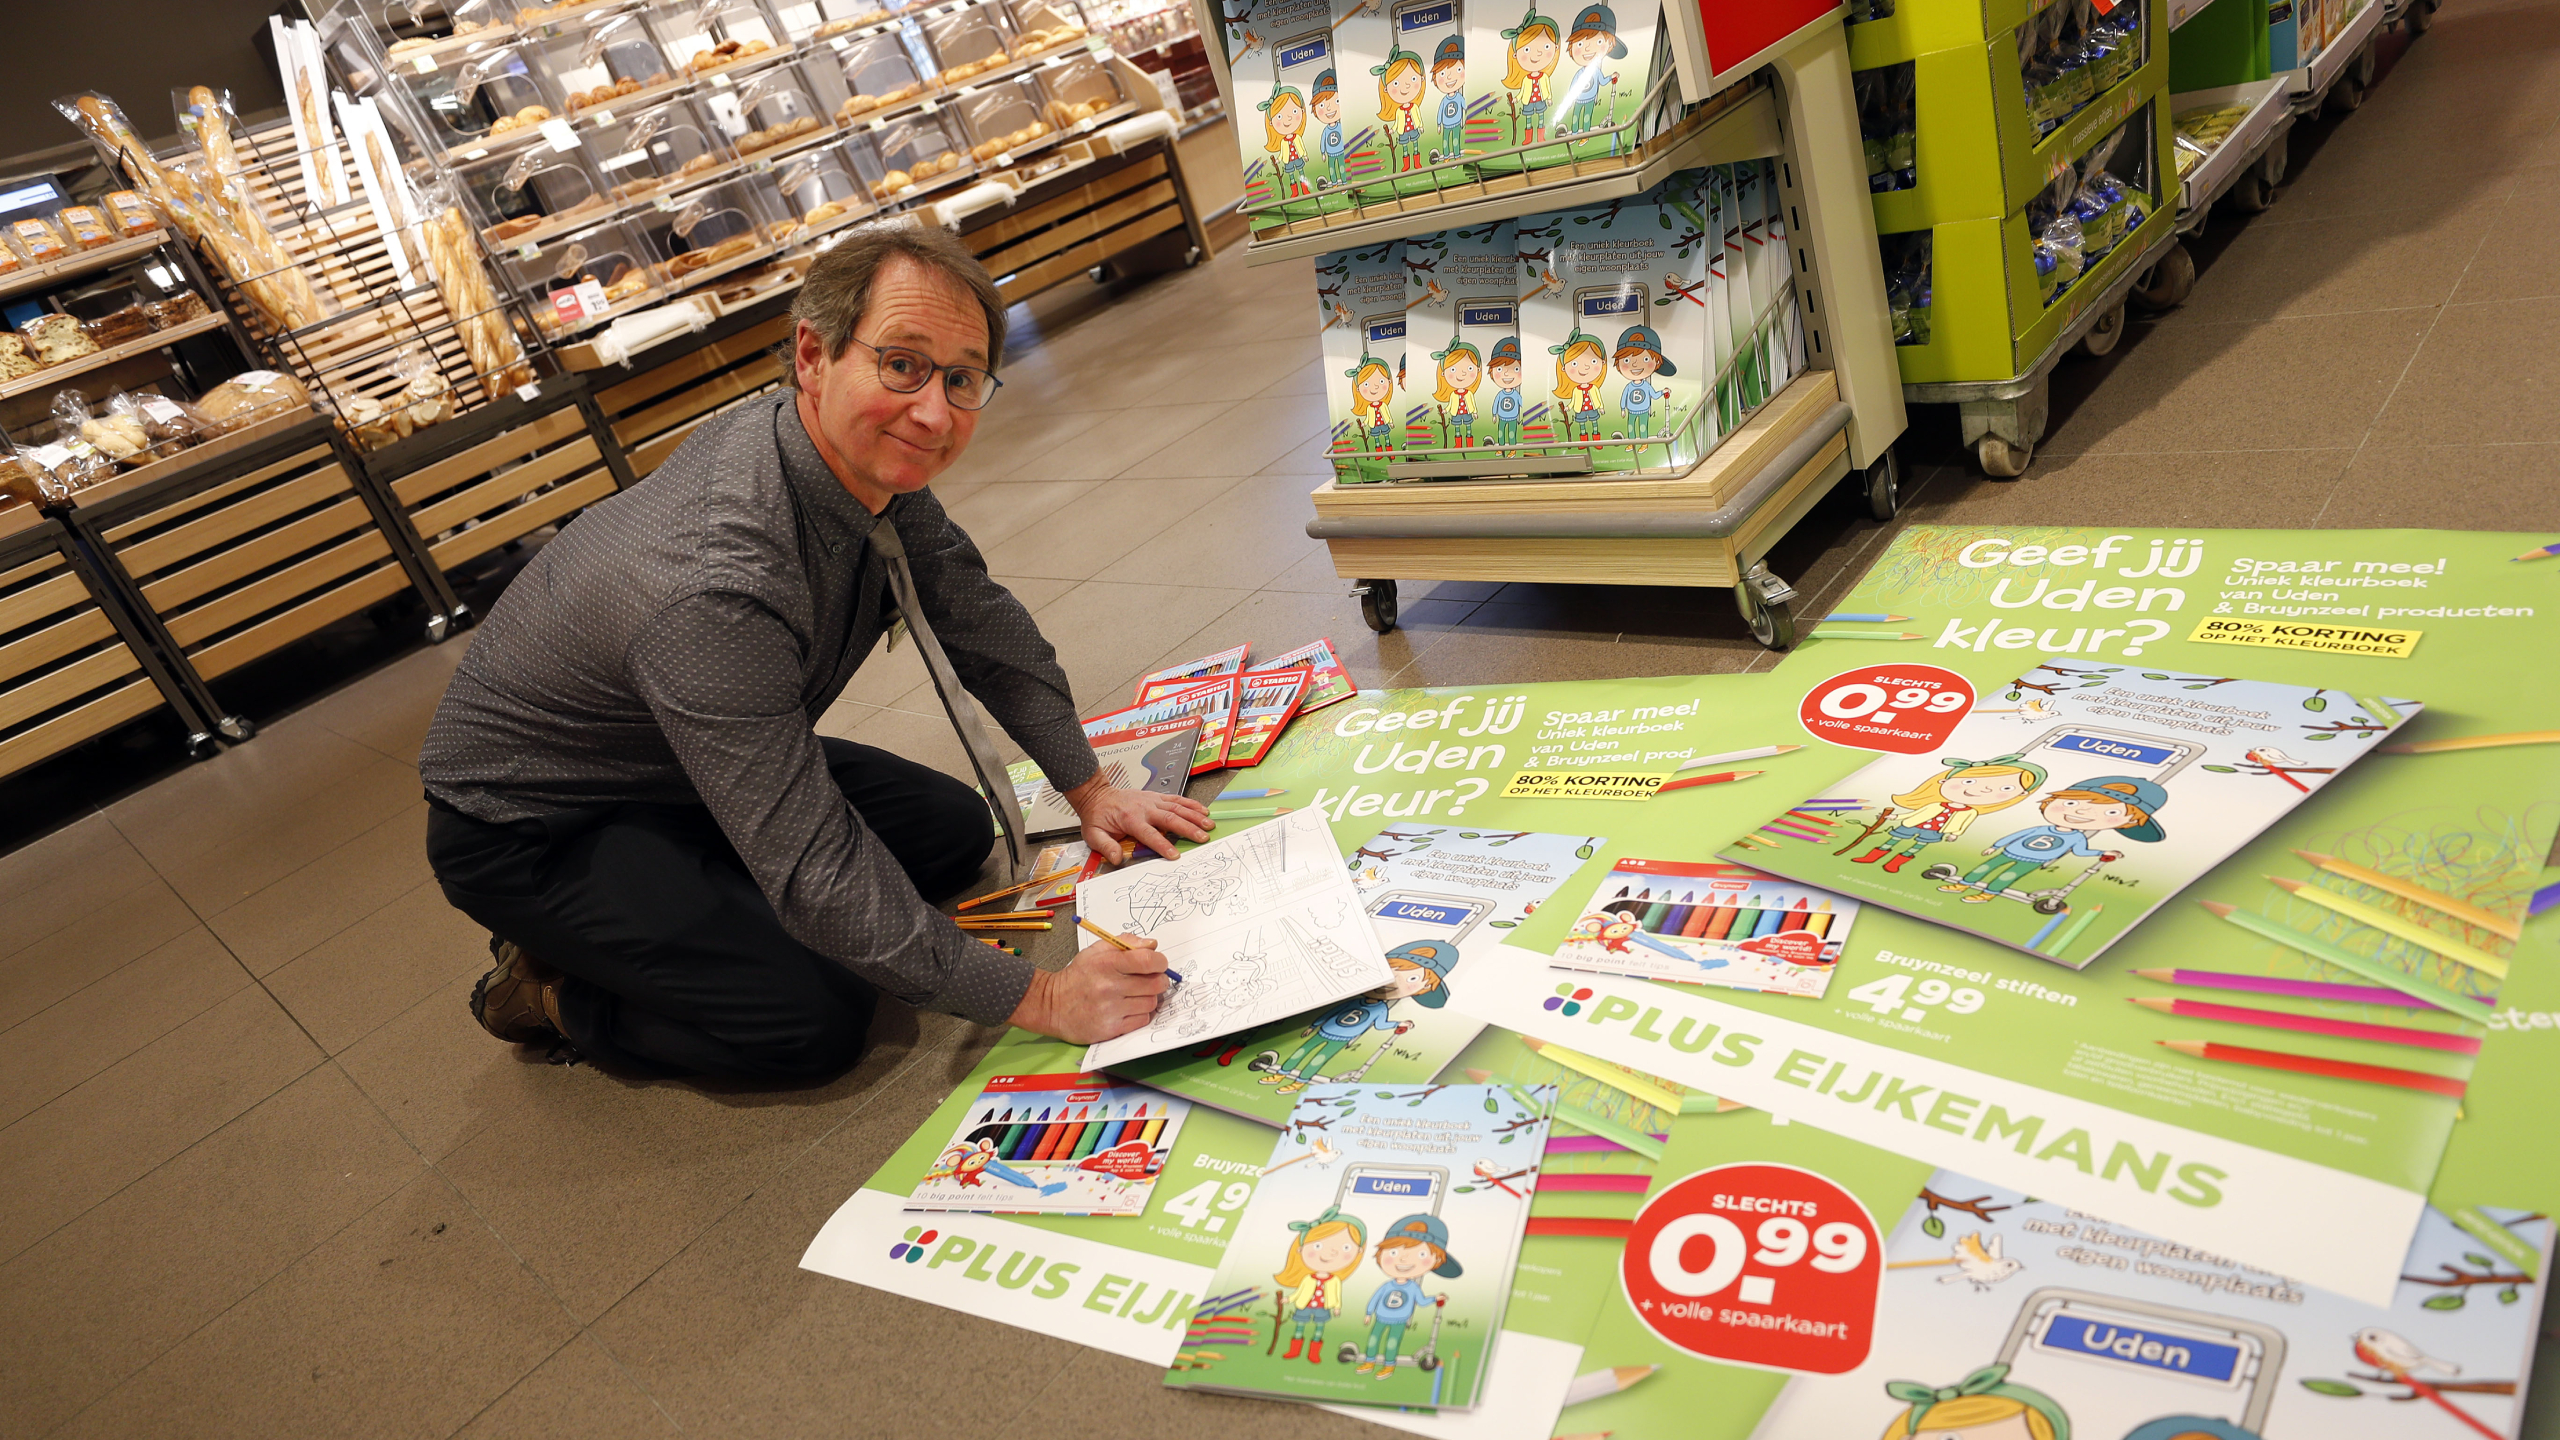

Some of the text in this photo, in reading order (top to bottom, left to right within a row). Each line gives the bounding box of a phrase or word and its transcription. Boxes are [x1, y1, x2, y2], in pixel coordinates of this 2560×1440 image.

[1256, 9, 1271, 21] met
[1272, 0, 1312, 17] kleurplaten
[1270, 6, 1332, 28] eigen woonplaats
[1413, 10, 1440, 26] Uden
[1290, 47, 1315, 62] Uden
[2072, 118, 2098, 148] massieve
[1569, 238, 1655, 251] Een uniek kleurboek
[1453, 254, 1468, 263] Een
[1469, 254, 1490, 263] uniek
[1578, 251, 1628, 263] kleurplaten
[1629, 251, 1642, 261] uit
[1642, 250, 1666, 262] jouw
[1443, 265, 1459, 274] met
[1460, 264, 1504, 276] kleurplaten
[1574, 262, 1649, 275] eigen woonplaats
[1354, 272, 1388, 285] Een uniek
[1456, 276, 1477, 287] eigen
[1347, 282, 1402, 296] met kleurplaten
[1359, 296, 1380, 306] eigen
[1596, 300, 1626, 312] Uden
[1474, 311, 1501, 322] Uden
[1380, 325, 1404, 337] Uden
[1958, 534, 2205, 578] Geef jij
[2230, 557, 2448, 578] Spaar mee!
[2223, 574, 2429, 589] Uniek kleurboek
[1988, 578, 2187, 613] Uden
[2219, 588, 2340, 602] van Uden
[2211, 601, 2535, 620] & Bruynzeel producten
[1932, 618, 2171, 657] kleur?
[2206, 621, 2408, 645] 80% KORTING
[2199, 632, 2402, 655] OP HET KLEURBOEK
[1262, 675, 1300, 686] STABILO
[1873, 675, 1943, 690] SLECHTS
[1190, 682, 1228, 699] STABILO
[2071, 691, 2282, 734] met kleurplaten uit jouw
[2103, 686, 2273, 721] Een uniek kleurboek
[1334, 694, 1528, 738] Geef jij
[1542, 697, 1701, 730] Spaar mee!
[2085, 704, 2236, 737] eigen woonplaats
[1149, 717, 1196, 735] STABILO
[1536, 720, 1685, 741] Uniek kleurboek
[1818, 717, 1851, 730] volle
[1853, 723, 1933, 741] spaarkaart
[1523, 746, 1697, 768] & Bruynzeel prod
[1531, 740, 1620, 755] van Uden
[2077, 737, 2143, 760] Uden
[1352, 740, 1507, 775] Uden
[1515, 775, 1663, 788] 80% KORTING
[1532, 787, 1560, 796] HET
[1563, 788, 1656, 798] KLEURBOEK
[1400, 856, 1557, 884] met kleurplaten uit jouw
[1426, 849, 1551, 872] Een uniek kleurboek
[1409, 869, 1521, 892] eigen woonplaats
[1396, 903, 1447, 921] Uden
[1770, 937, 1810, 947] Discover
[1576, 953, 1595, 963] big
[1596, 957, 1626, 966] point
[1628, 959, 1648, 967] felt
[1649, 962, 1671, 971] tips
[1874, 949, 2079, 1008] Bruynzeel stiften
[1845, 1009, 1876, 1024] volle
[1877, 1017, 1952, 1044] spaarkaart
[1586, 994, 1765, 1068] PLUS
[1771, 1048, 2230, 1210] EIJKEMANS
[1359, 1113, 1473, 1132] Een uniek kleurboek
[1340, 1124, 1483, 1145] met kleurplaten uit jouw
[1356, 1138, 1458, 1155] eigen woonplaats
[1117, 1156, 1143, 1164] world!
[1370, 1179, 1413, 1195] Uden
[915, 1191, 1014, 1203] 10 big point felt tips
[1711, 1193, 1818, 1218] SLECHTS
[1157, 1225, 1183, 1239] volle
[2023, 1217, 2078, 1238] met
[925, 1235, 1198, 1332] PLUS EIJK
[2056, 1245, 2130, 1272] eigen
[2134, 1257, 2305, 1305] woonplaats
[1639, 1298, 1850, 1341] + volle spaarkaart
[2081, 1323, 2192, 1370] Uden
